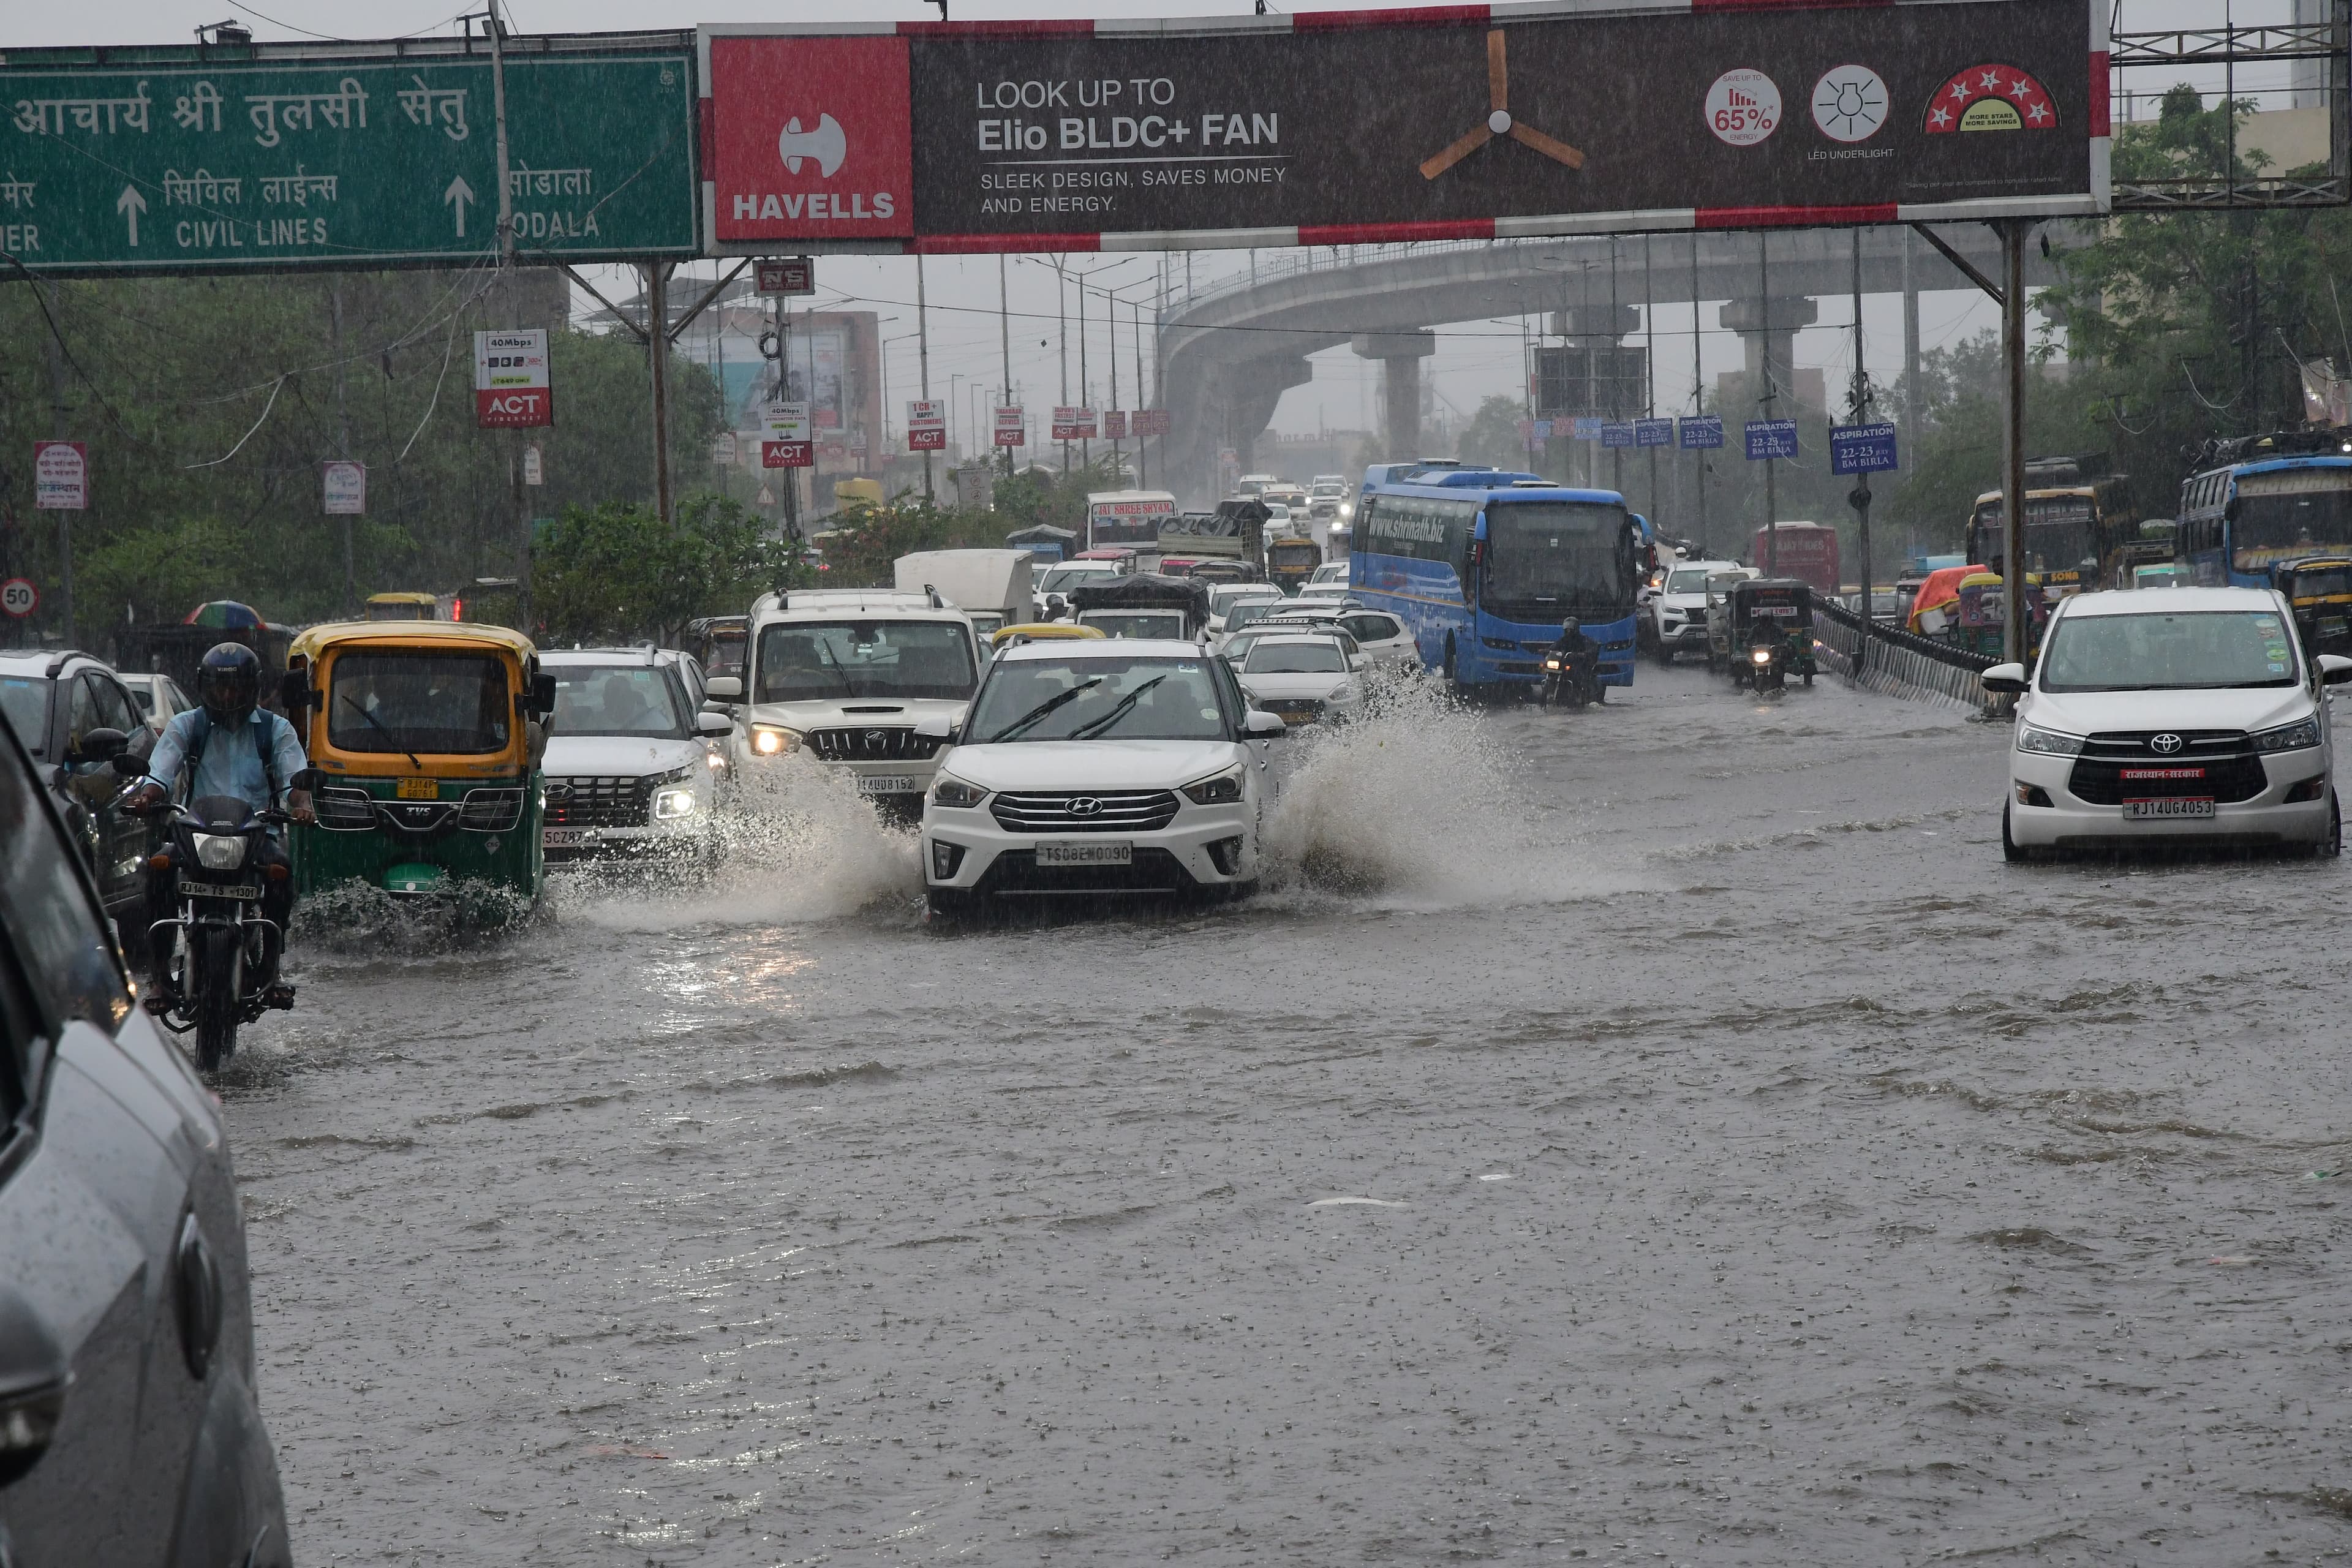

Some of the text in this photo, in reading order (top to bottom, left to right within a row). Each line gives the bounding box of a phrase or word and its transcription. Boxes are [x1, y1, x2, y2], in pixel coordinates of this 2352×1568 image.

[978, 77, 1175, 109] LOOK UP TO
[13, 74, 469, 148] आचार्य श्री तुलसी सेतु
[978, 112, 1278, 152] Elio BLDC+ FAN
[1807, 148, 1894, 160] LED UNDERLIGHT
[509, 159, 592, 197] सोडाला
[981, 166, 1287, 190] SLEEK DESIGN, SAVES MONEY
[162, 165, 338, 207] सिविल लाईन्स
[733, 191, 894, 221] HAVELLS
[981, 195, 1116, 214] AND ENERGY.
[497, 211, 600, 238] ODALA
[0, 225, 40, 251] ER
[176, 217, 327, 248] CIVIL LINES
[491, 338, 532, 347] 40Mbps
[488, 395, 540, 415] ACT
[919, 402, 930, 412] CR
[1746, 423, 1795, 432] ASPIRATION
[1833, 427, 1894, 440] ASPIRATION
[914, 432, 940, 442] ACT
[999, 432, 1020, 440] ACT
[1752, 437, 1778, 447] 22-23
[769, 445, 804, 459] ACT
[1841, 446, 1874, 459] 22-23
[1842, 456, 1889, 469] BM BIRLA
[1098, 502, 1170, 516] JAI SHREE SHYAM
[1368, 514, 1446, 543] www.shrinath.biz
[2051, 571, 2079, 582] SONA
[6, 589, 29, 605] 50
[406, 807, 431, 816] TVS
[2133, 801, 2212, 815] RJ14UG4053
[212, 886, 225, 895] TS
